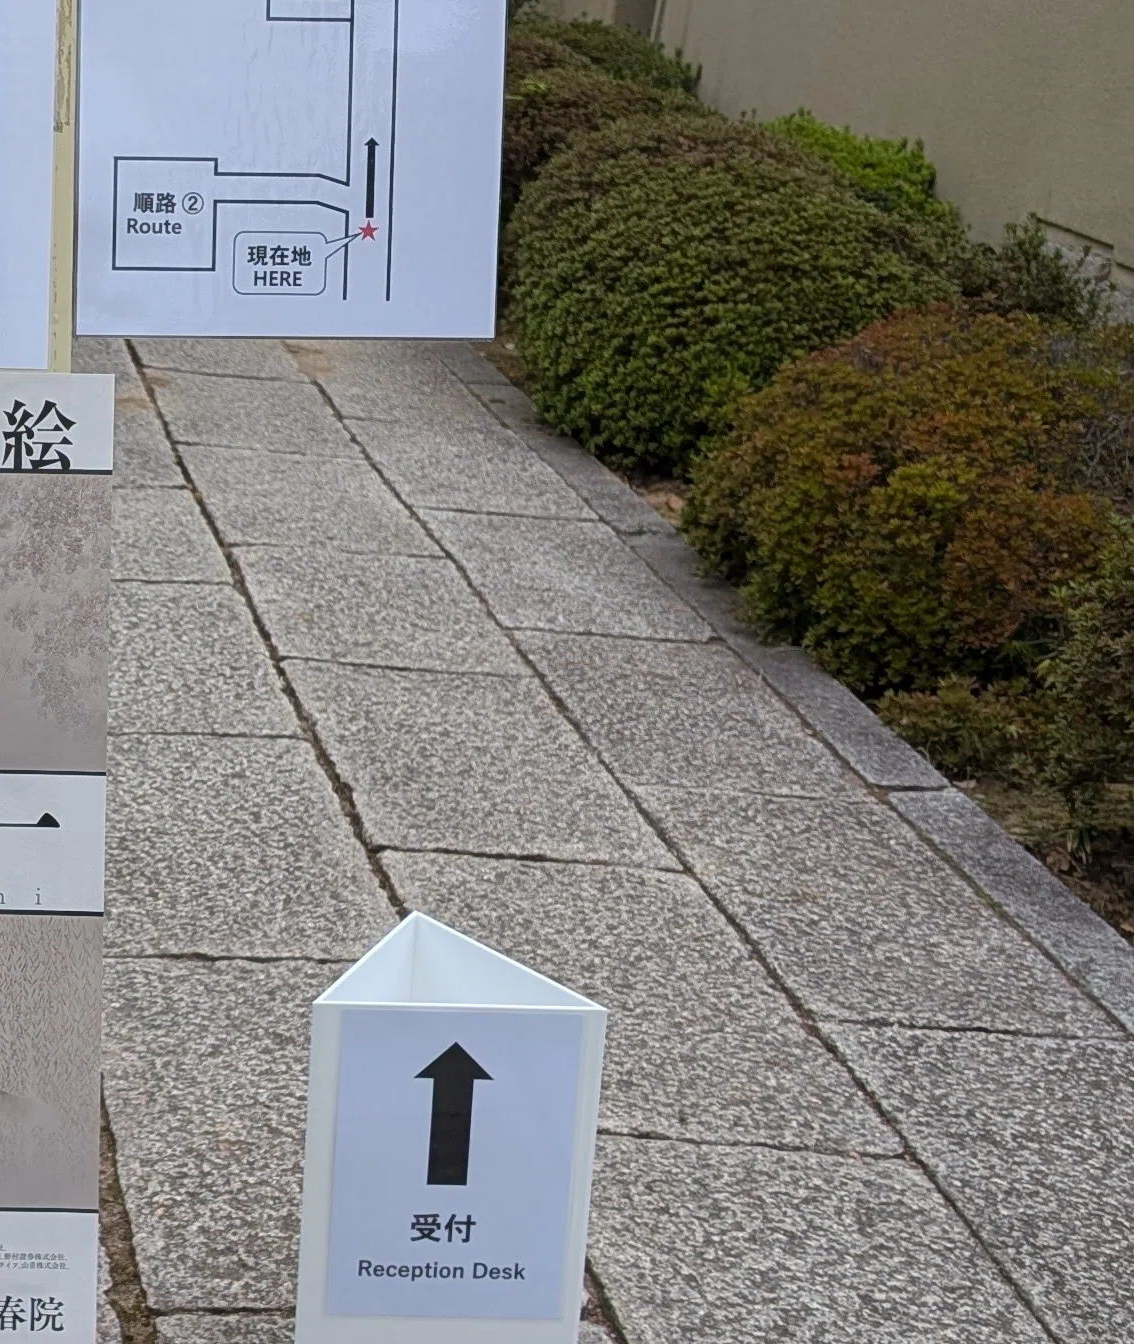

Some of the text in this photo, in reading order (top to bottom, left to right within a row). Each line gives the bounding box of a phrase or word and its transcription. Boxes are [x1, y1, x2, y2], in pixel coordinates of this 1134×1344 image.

[133, 193, 176, 214] 順路
[127, 218, 182, 234] Route
[247, 245, 311, 266] 現在地
[254, 271, 302, 286] HERE
[411, 1214, 476, 1243] 受付
[358, 1260, 525, 1281] Reception Desk
